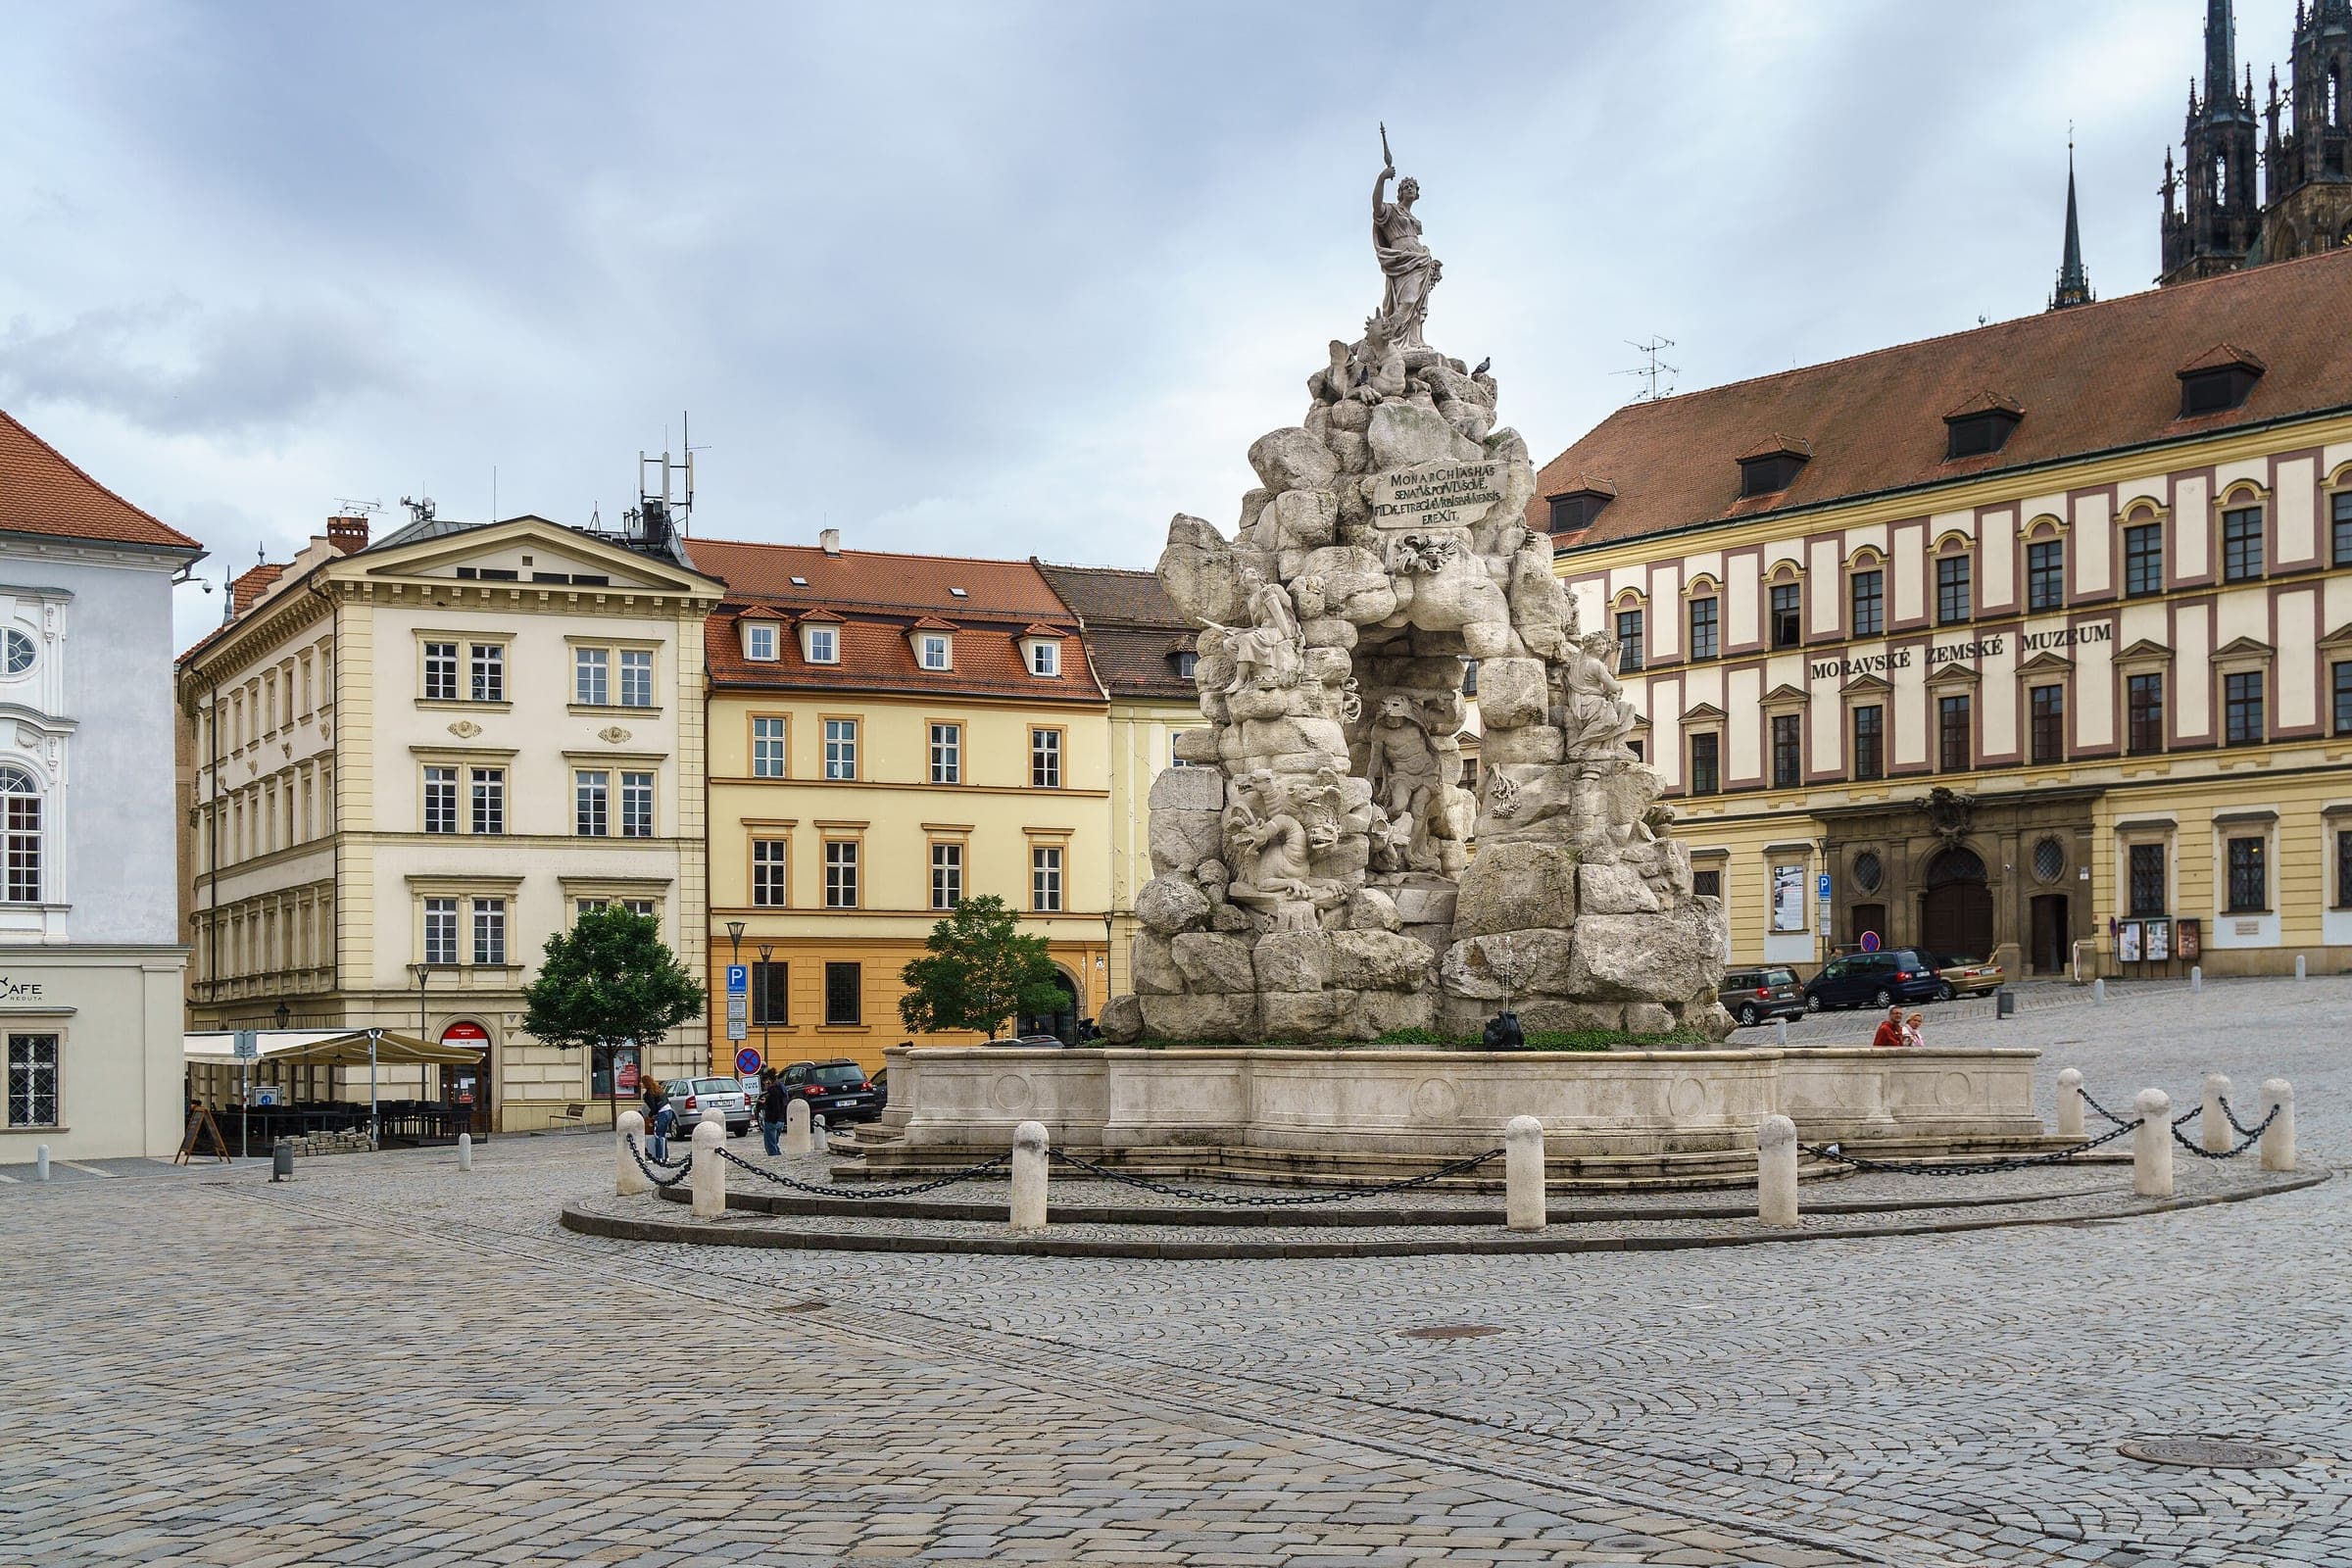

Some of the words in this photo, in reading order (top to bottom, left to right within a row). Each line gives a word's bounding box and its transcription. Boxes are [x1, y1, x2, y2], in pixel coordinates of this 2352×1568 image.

[1810, 647, 1911, 680] MORAVSKÉ
[1925, 634, 2003, 664] ZEMSKÉ
[2021, 623, 2112, 651] MUZEUM
[1821, 877, 1828, 891] P
[731, 968, 743, 984] P
